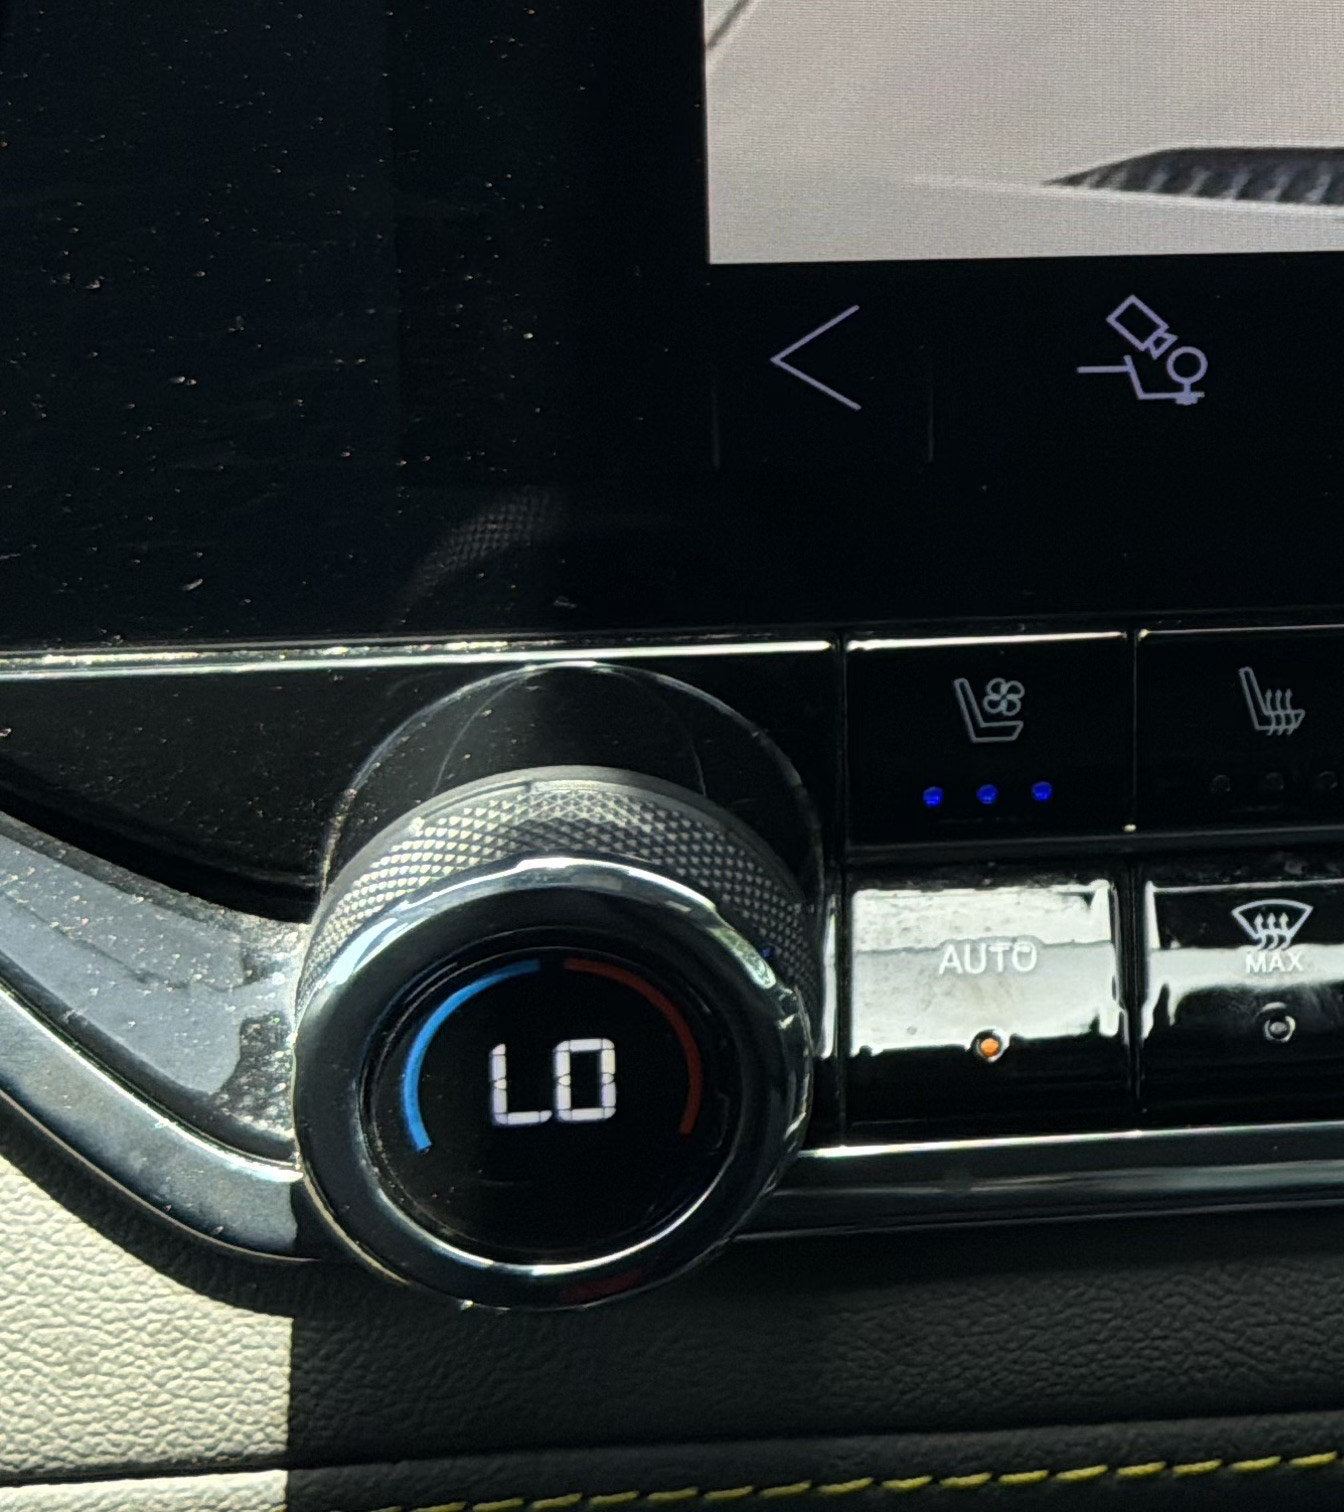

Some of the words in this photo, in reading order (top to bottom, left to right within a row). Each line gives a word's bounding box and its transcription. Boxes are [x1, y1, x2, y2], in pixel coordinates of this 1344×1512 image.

[938, 941, 1038, 975] AUTO
[1245, 949, 1303, 973] MAX
[488, 1037, 618, 1126] LO
